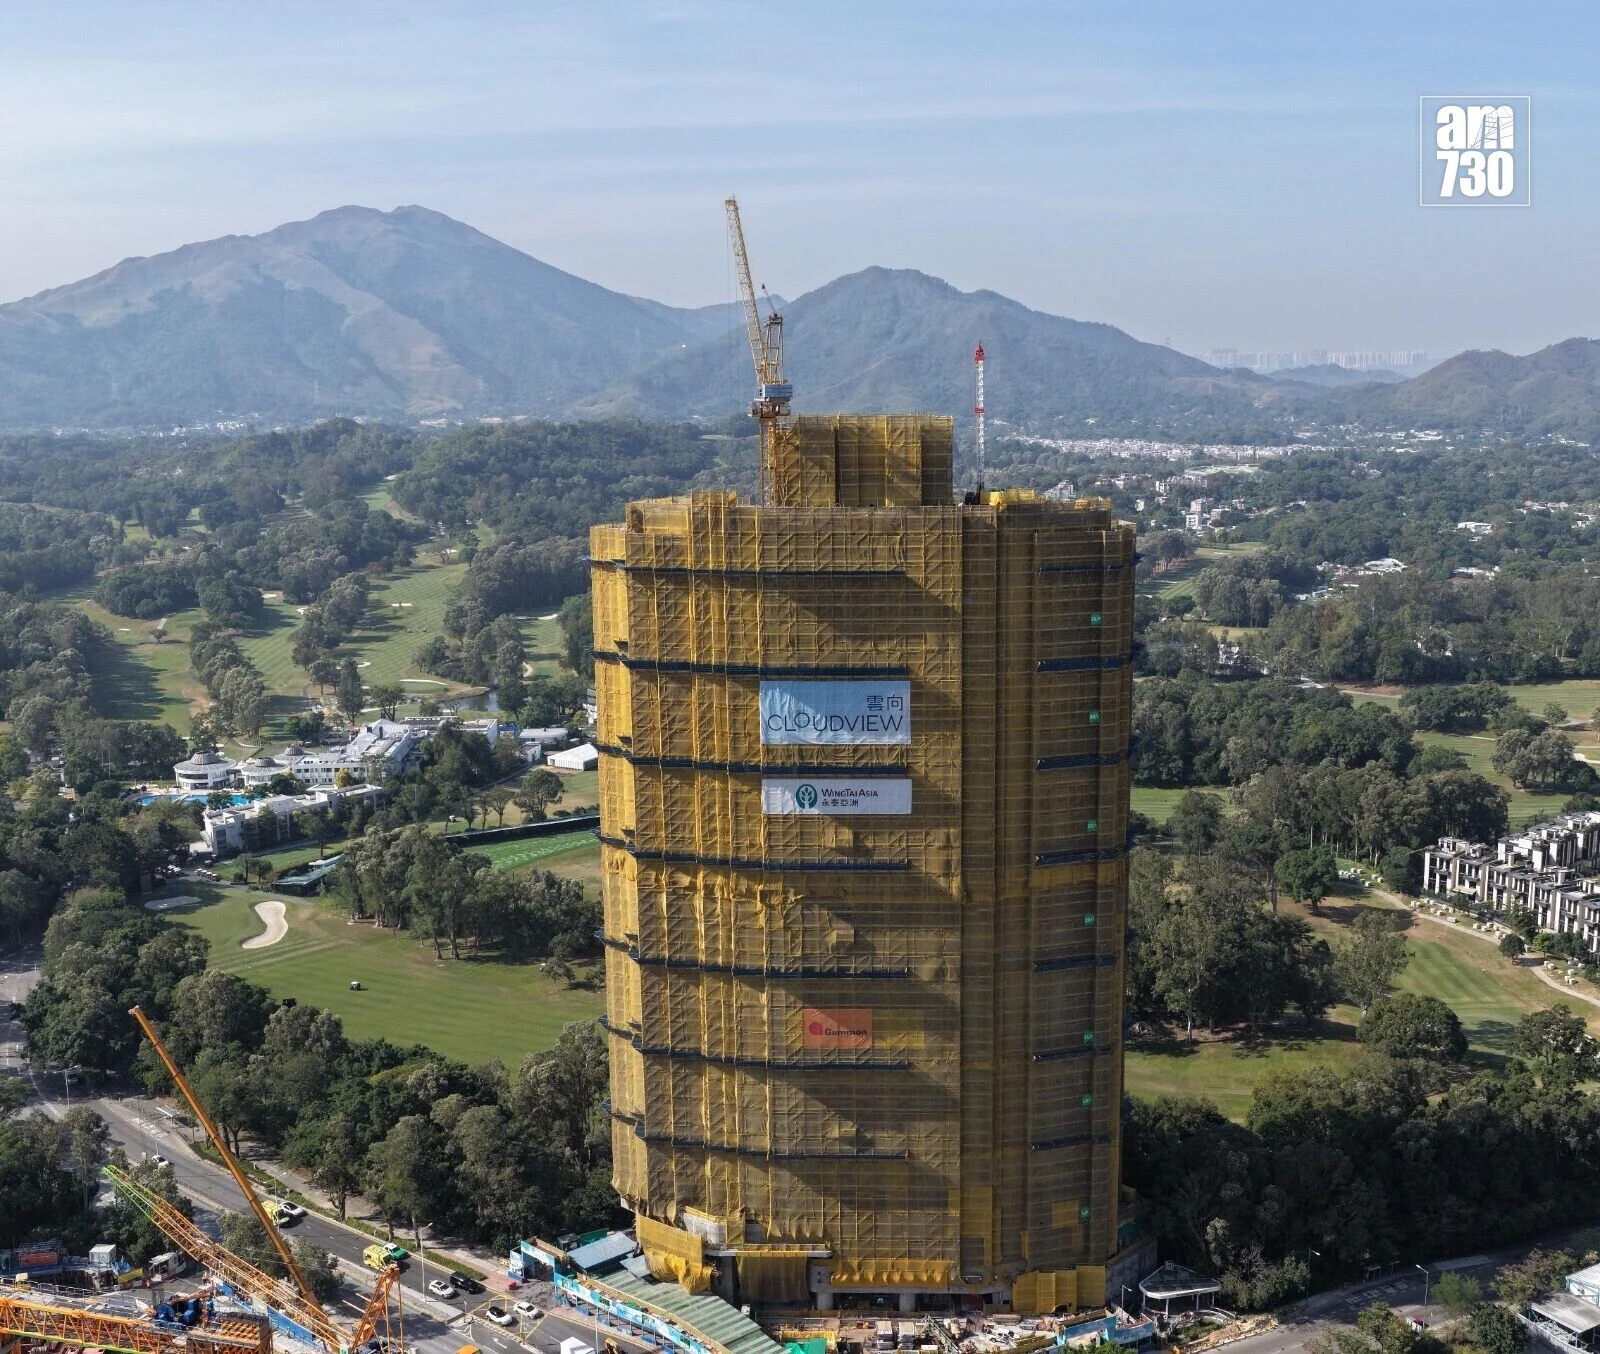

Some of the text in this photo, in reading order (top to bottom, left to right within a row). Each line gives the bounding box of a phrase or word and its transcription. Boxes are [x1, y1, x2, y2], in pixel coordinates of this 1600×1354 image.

[866, 694, 904, 712] 雲向
[767, 712, 903, 731] CLOUDVIEW
[825, 1028, 867, 1036] Gammon
